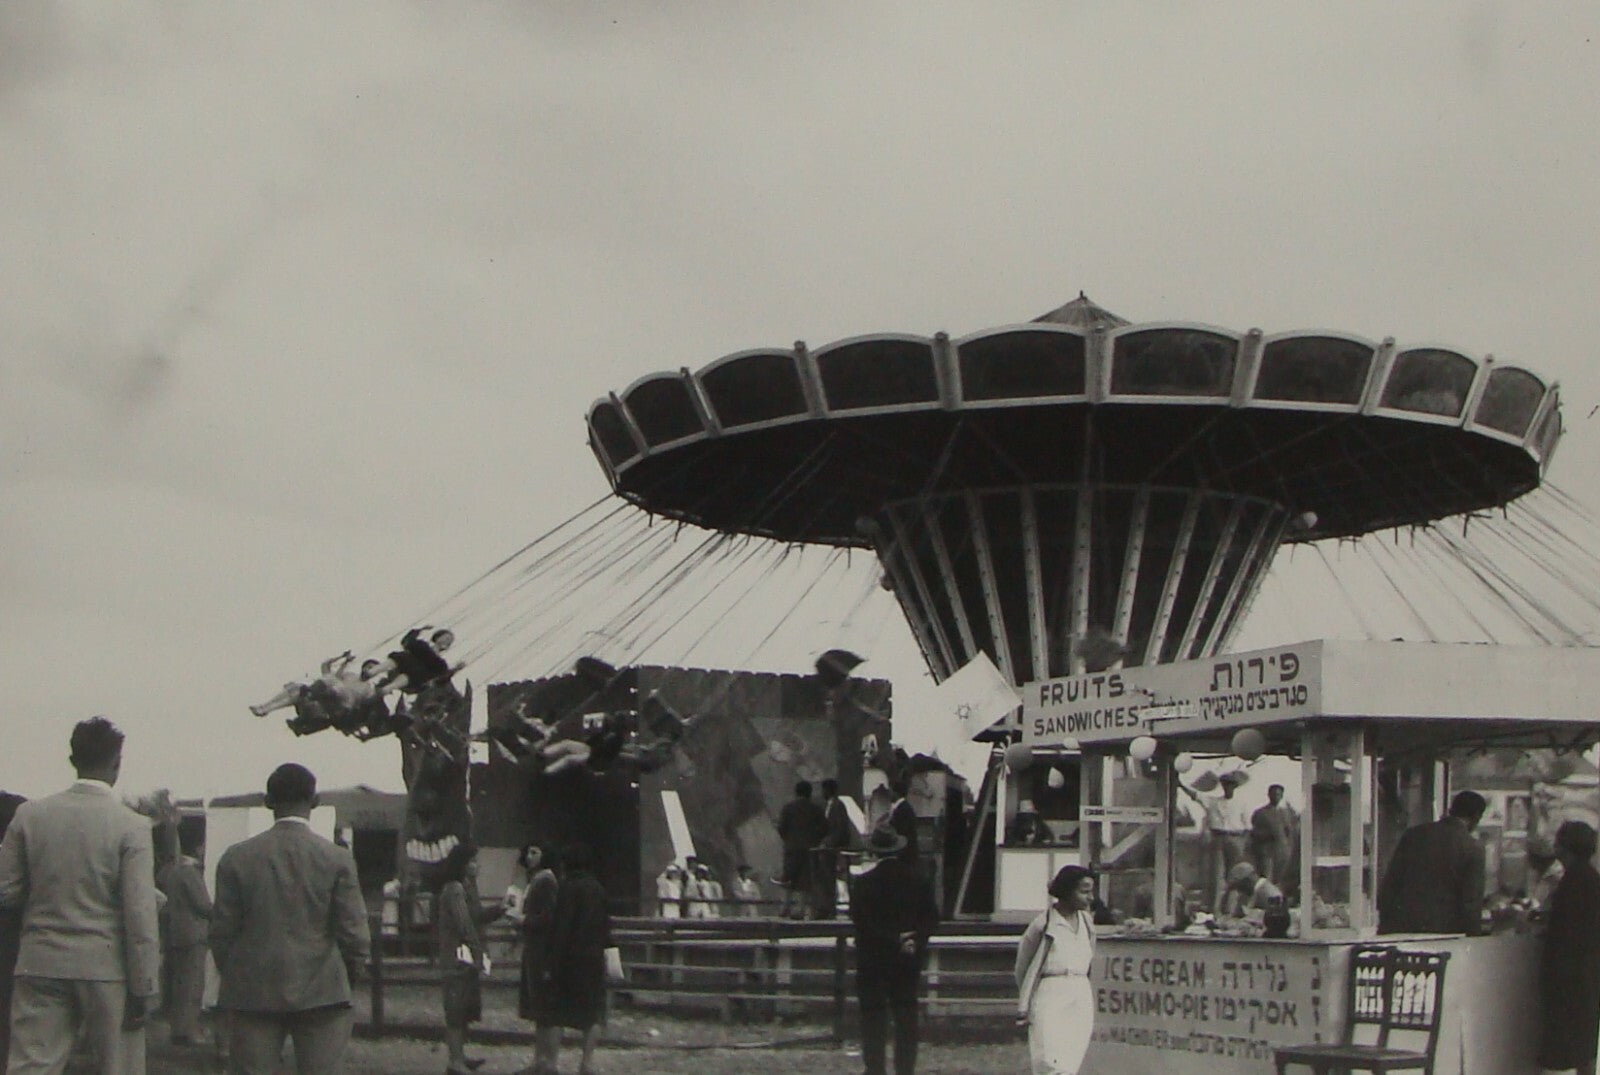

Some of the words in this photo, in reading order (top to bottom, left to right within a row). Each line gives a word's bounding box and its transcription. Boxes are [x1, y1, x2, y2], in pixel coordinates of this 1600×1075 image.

[1209, 652, 1300, 692] פירות
[1040, 674, 1125, 708] FRUITS
[1033, 704, 1139, 737] SANDWICHES
[1103, 956, 1134, 983] ICE
[1140, 957, 1206, 988] CREAM
[1221, 955, 1289, 992] גלידה
[1096, 988, 1209, 1021] ESKIMO-PIE
[1214, 997, 1299, 1034] אסקימו
